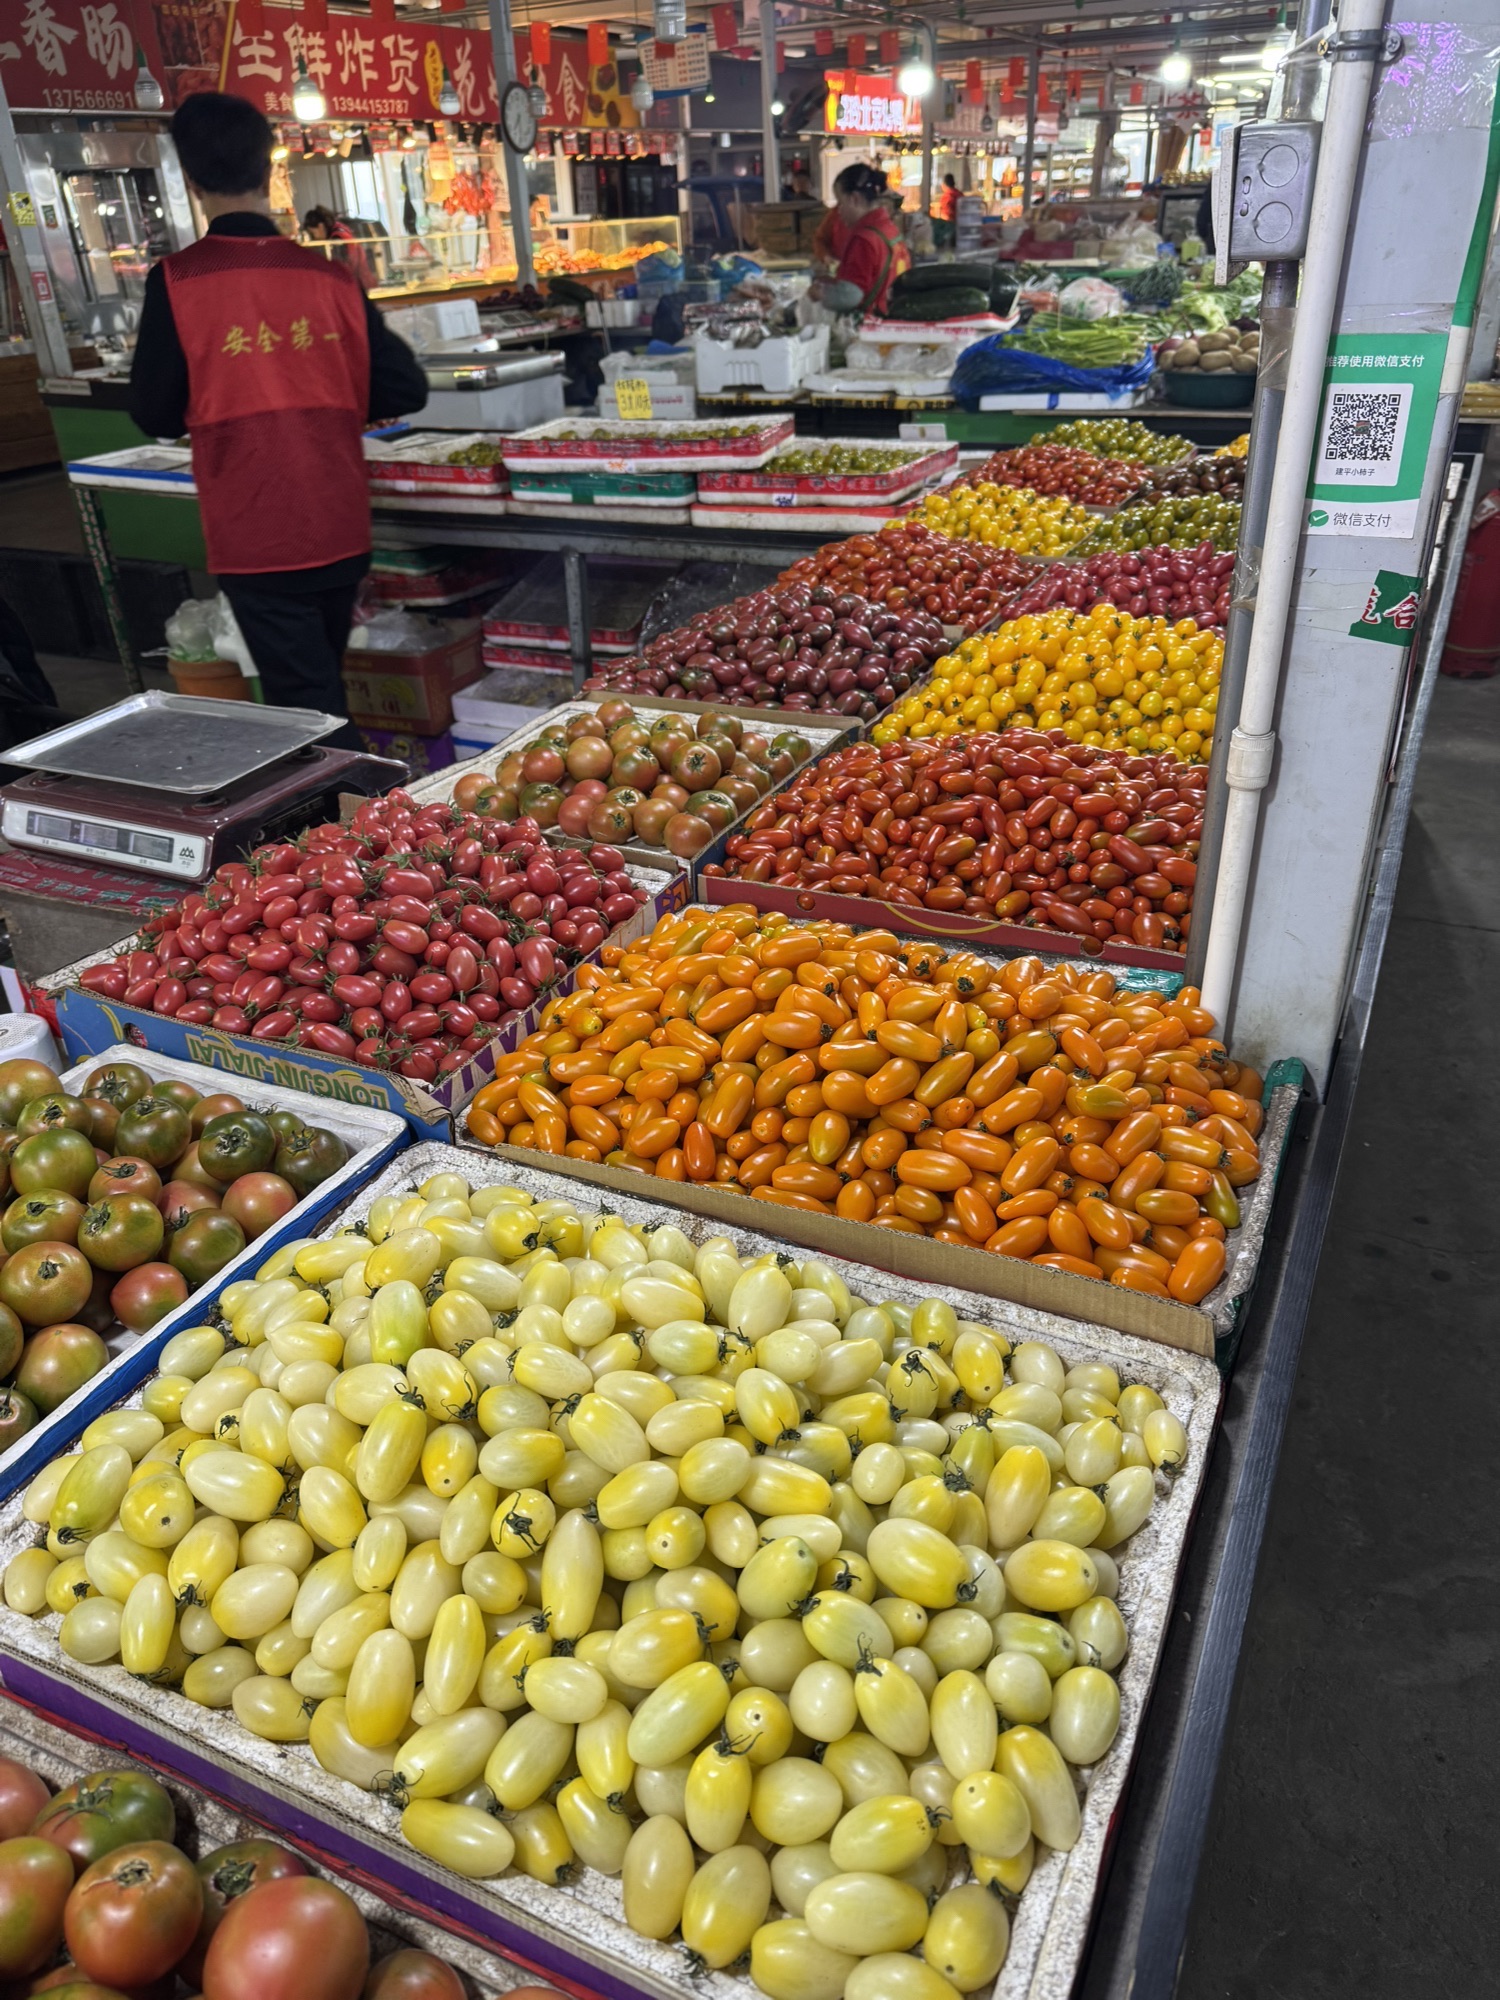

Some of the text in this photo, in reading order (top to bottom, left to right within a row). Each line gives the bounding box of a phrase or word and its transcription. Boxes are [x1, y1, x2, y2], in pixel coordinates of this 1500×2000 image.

[0, 0, 134, 79] 香肠
[233, 20, 420, 95] 生鲜炸货
[43, 89, 134, 109] 137566691
[332, 96, 409, 115] 13944153787
[221, 315, 340, 357] 安全第一
[1325, 354, 1425, 368] 推荐使用微信支付
[1335, 467, 1376, 477] 建平小柿子
[1333, 512, 1392, 528] 微信支付
[186, 1034, 390, 1110] LONGJIN-JIALAI
